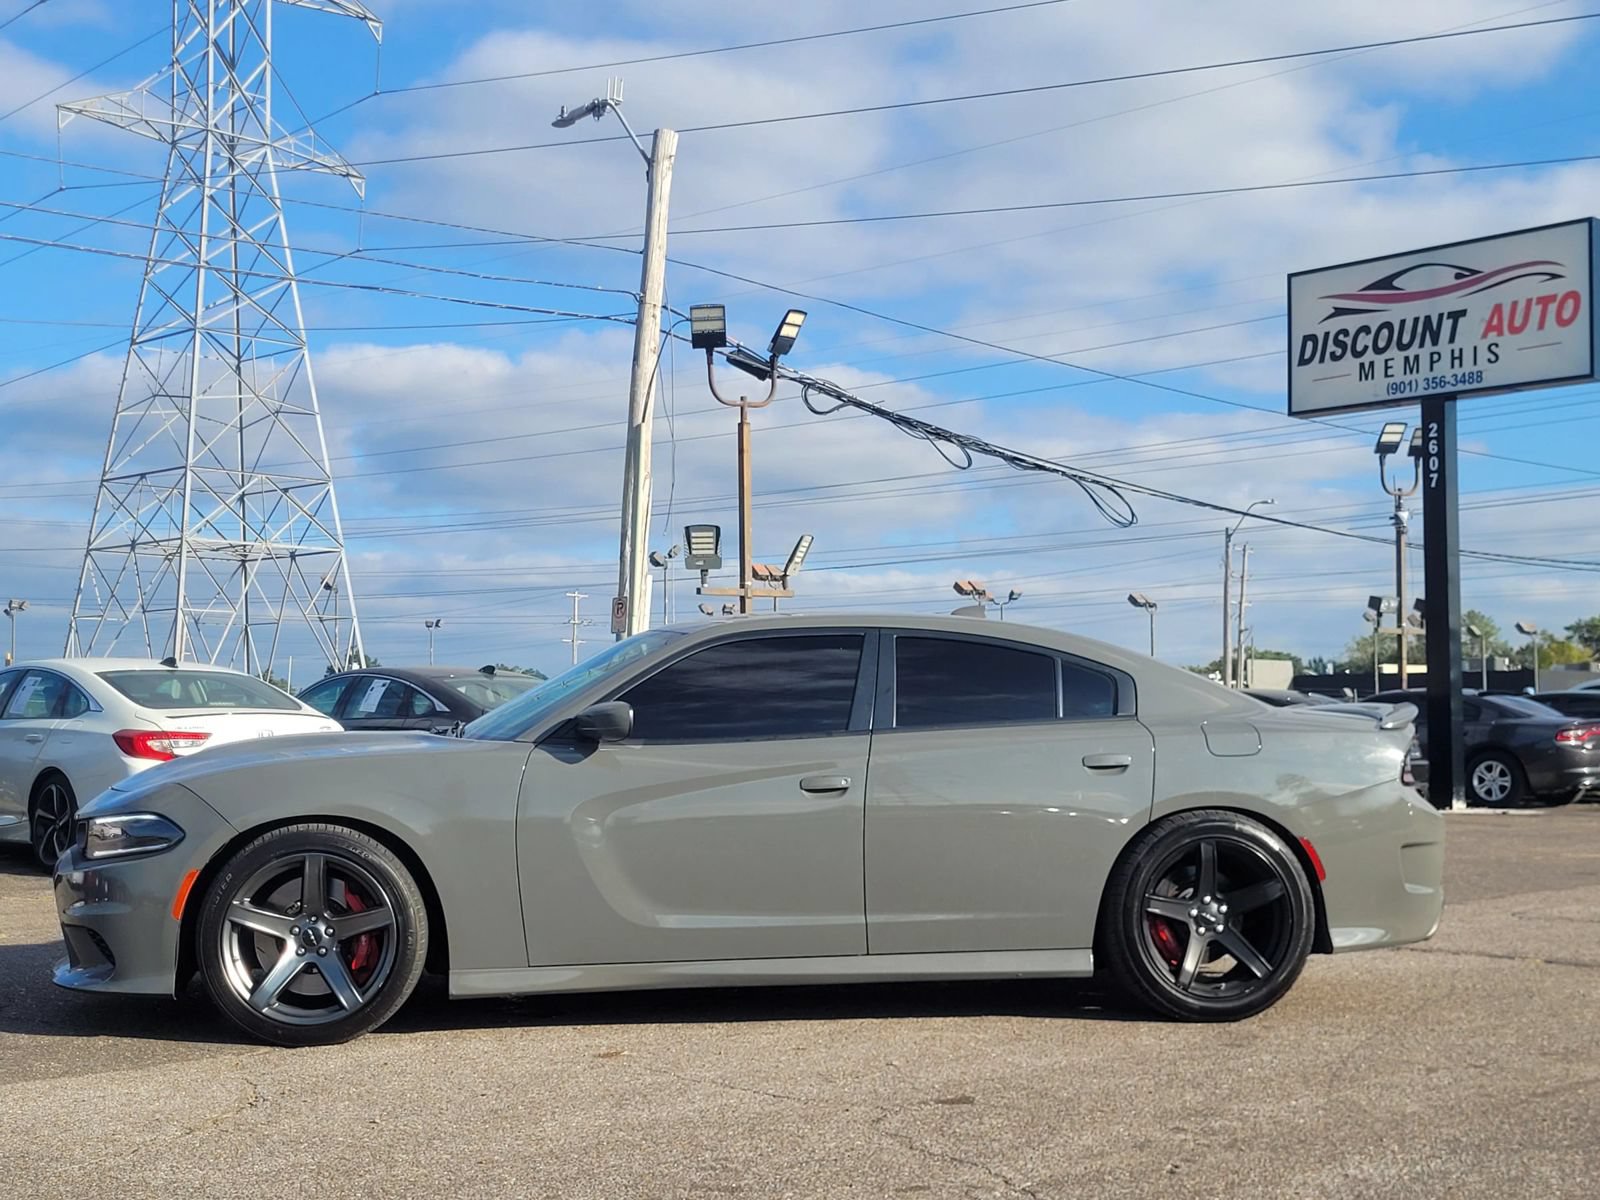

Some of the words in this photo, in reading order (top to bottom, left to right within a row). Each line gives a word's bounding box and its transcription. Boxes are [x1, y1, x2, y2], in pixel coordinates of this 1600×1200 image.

[1297, 308, 1468, 367] DISCOUNT
[1480, 290, 1582, 340] AUTO
[1358, 343, 1500, 382] MEMPHIS
[1386, 379, 1419, 396] (901)
[1423, 370, 1483, 391] 356-3488
[1428, 423, 1439, 488] 2607
